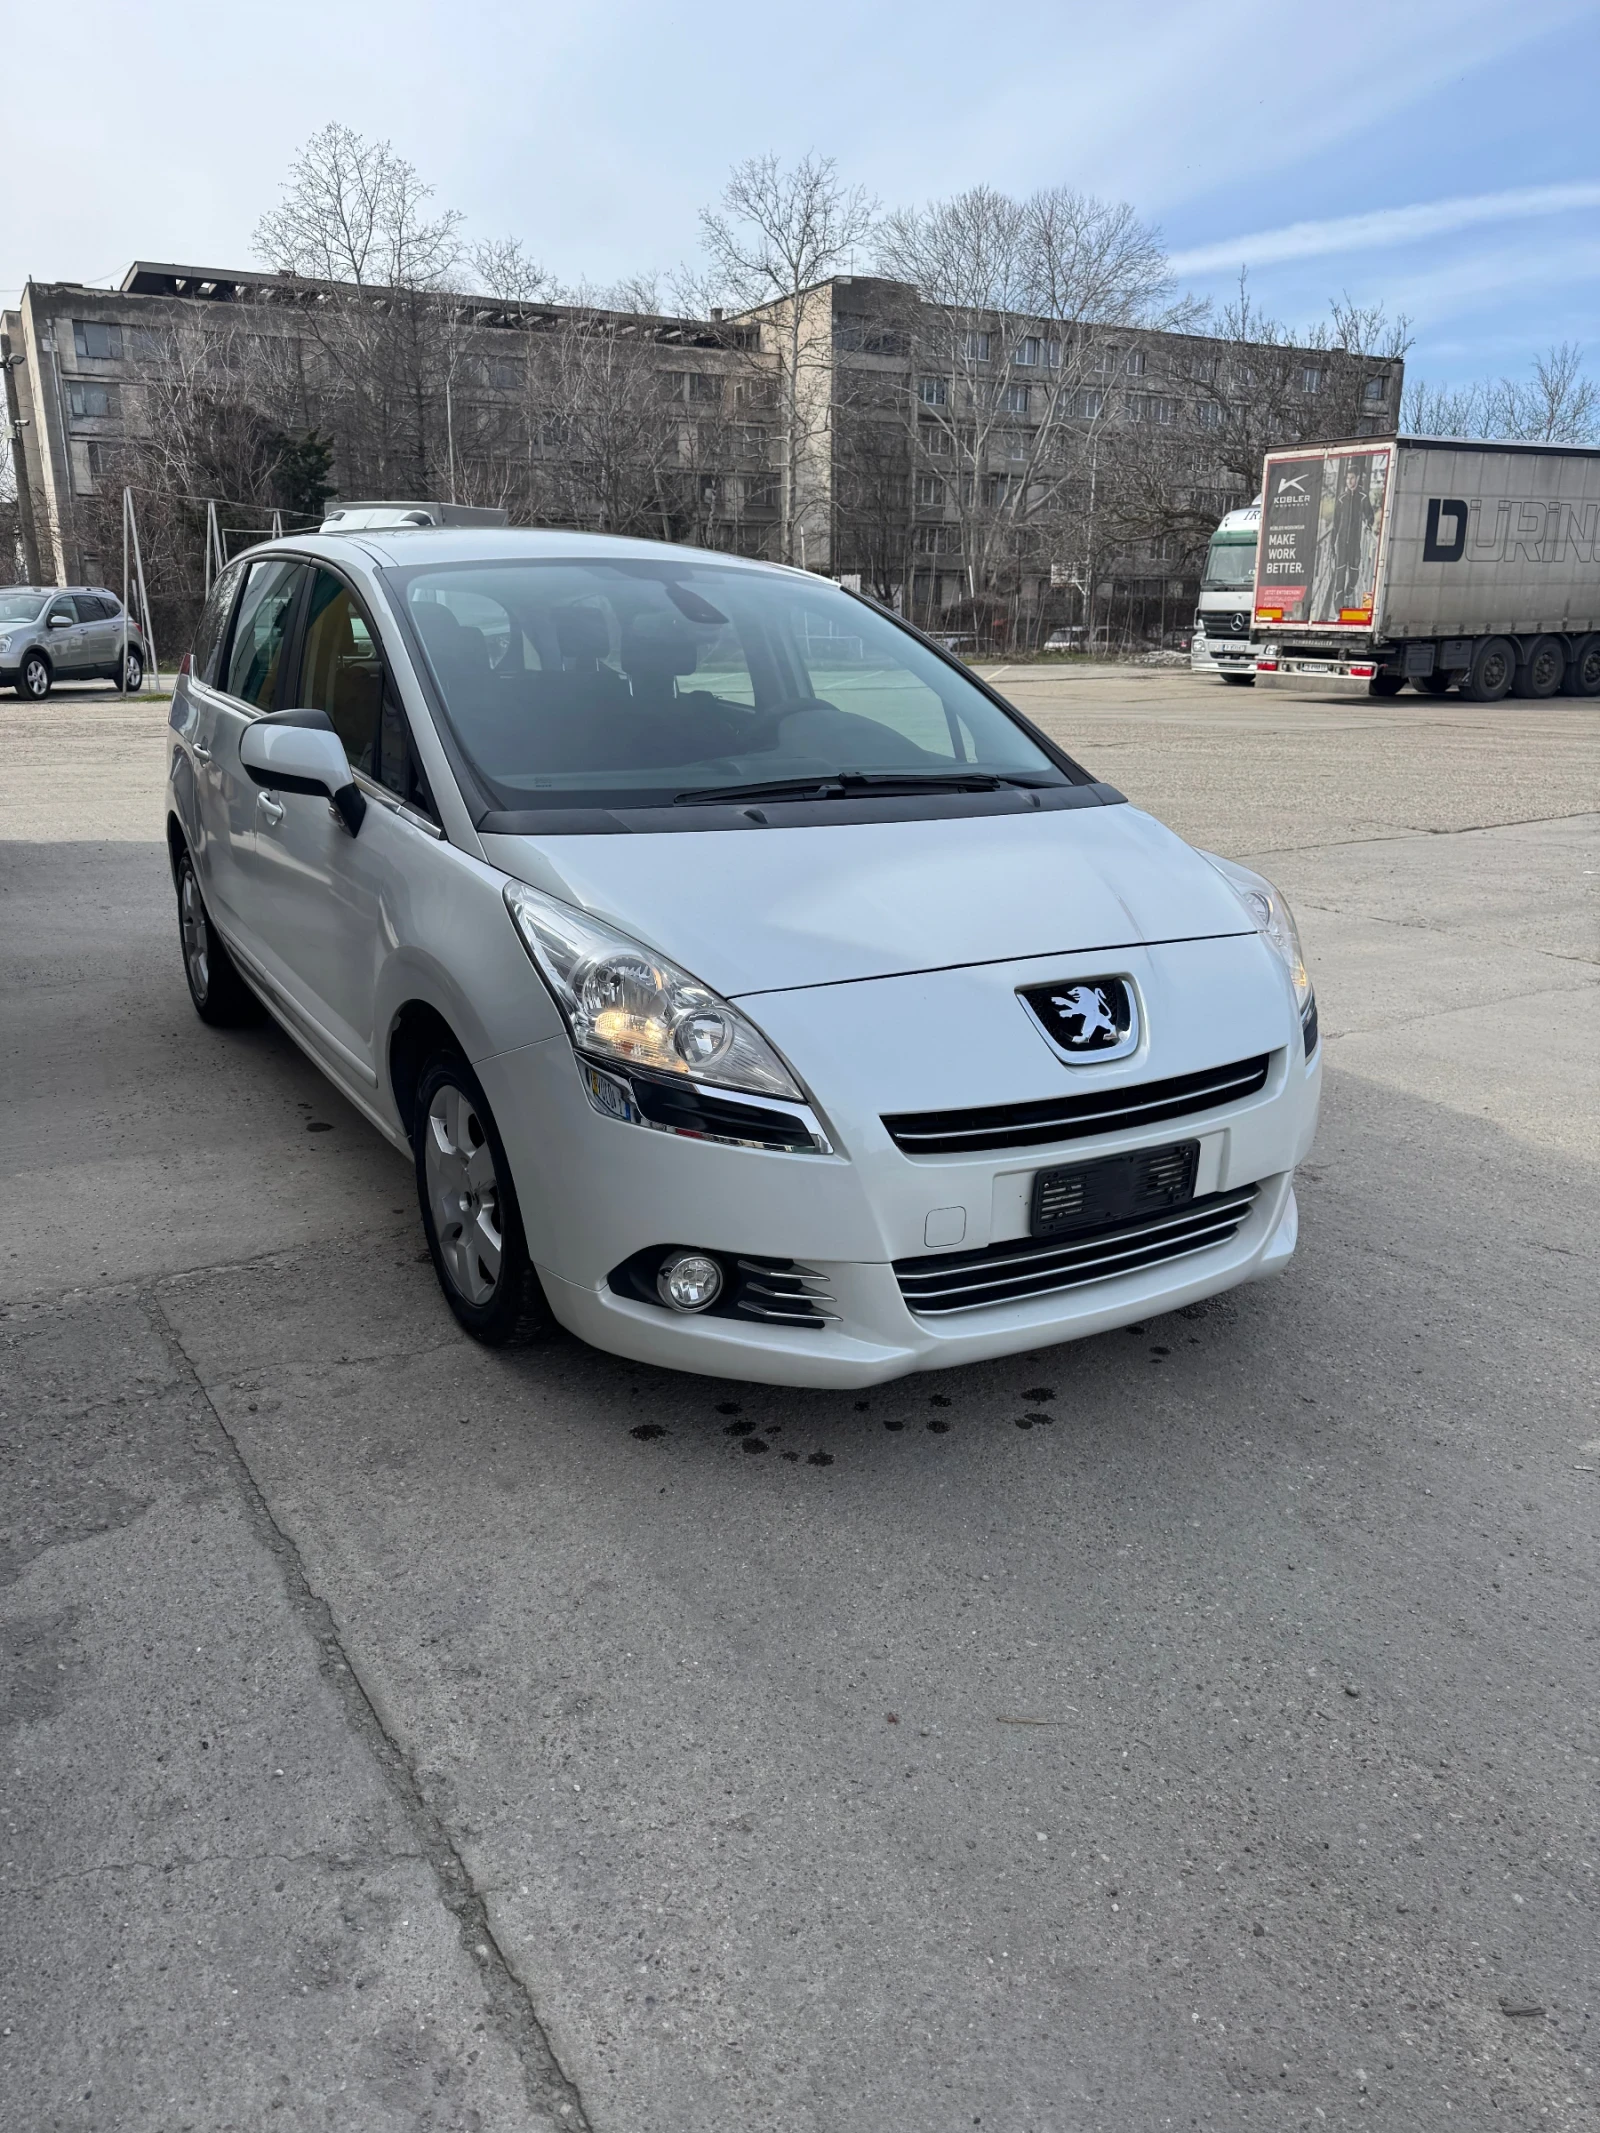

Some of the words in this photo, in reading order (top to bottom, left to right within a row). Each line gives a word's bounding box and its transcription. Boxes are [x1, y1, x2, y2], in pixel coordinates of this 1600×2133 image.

[1268, 533, 1296, 546] MAKE
[1268, 547, 1296, 560] WORK
[1266, 562, 1305, 574] BETTER.
